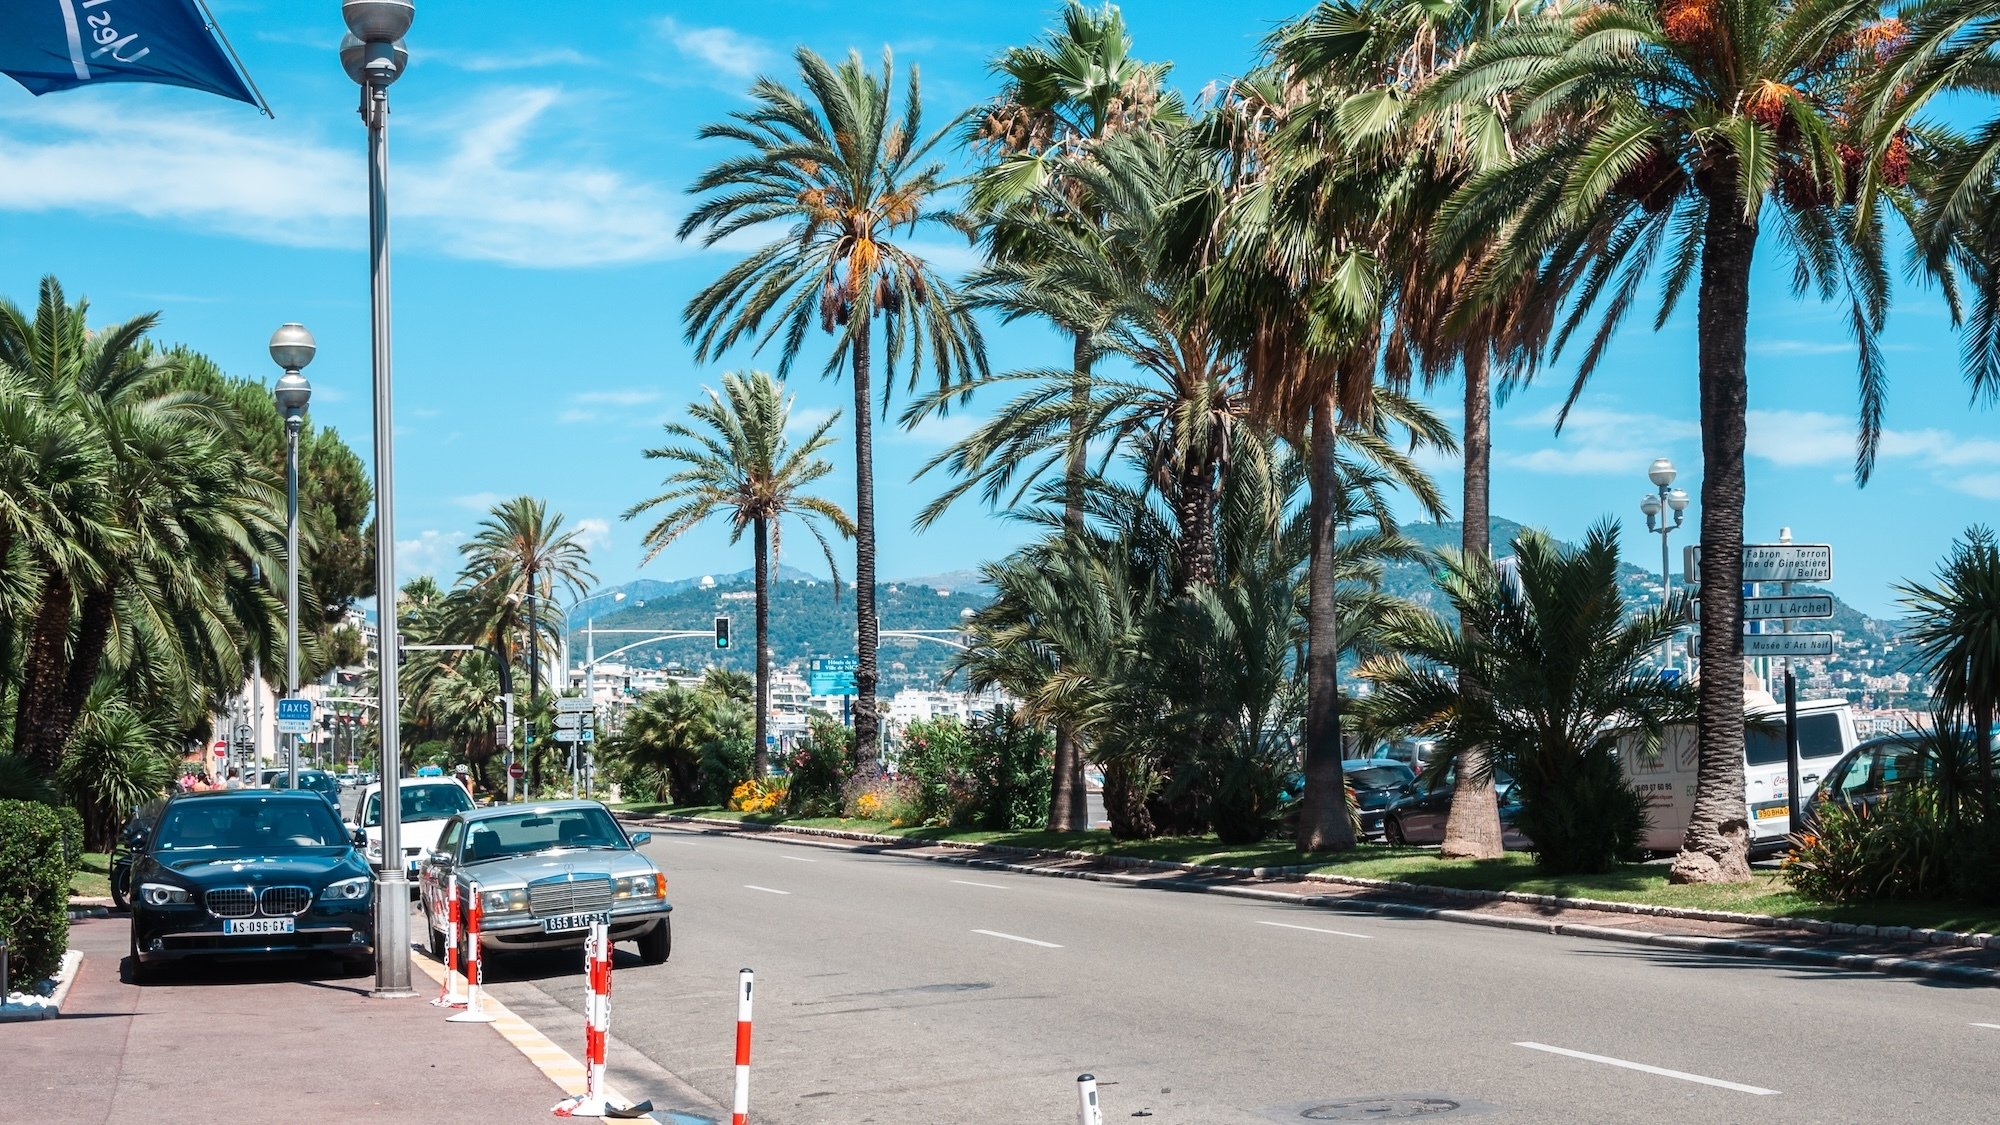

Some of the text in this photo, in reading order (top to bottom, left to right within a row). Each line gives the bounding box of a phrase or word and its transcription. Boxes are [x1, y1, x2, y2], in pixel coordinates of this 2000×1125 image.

[1746, 549, 1781, 559] Fabron
[1796, 549, 1827, 558] Terron
[1763, 559, 1775, 568] de
[1778, 559, 1827, 568] Ginestière
[1797, 568, 1828, 577] Bellet
[1752, 641, 1780, 650] Musée
[281, 703, 309, 713] TAXIS
[232, 920, 285, 933] AS-096-GX
[550, 916, 569, 930] 655
[572, 914, 590, 928] EKF
